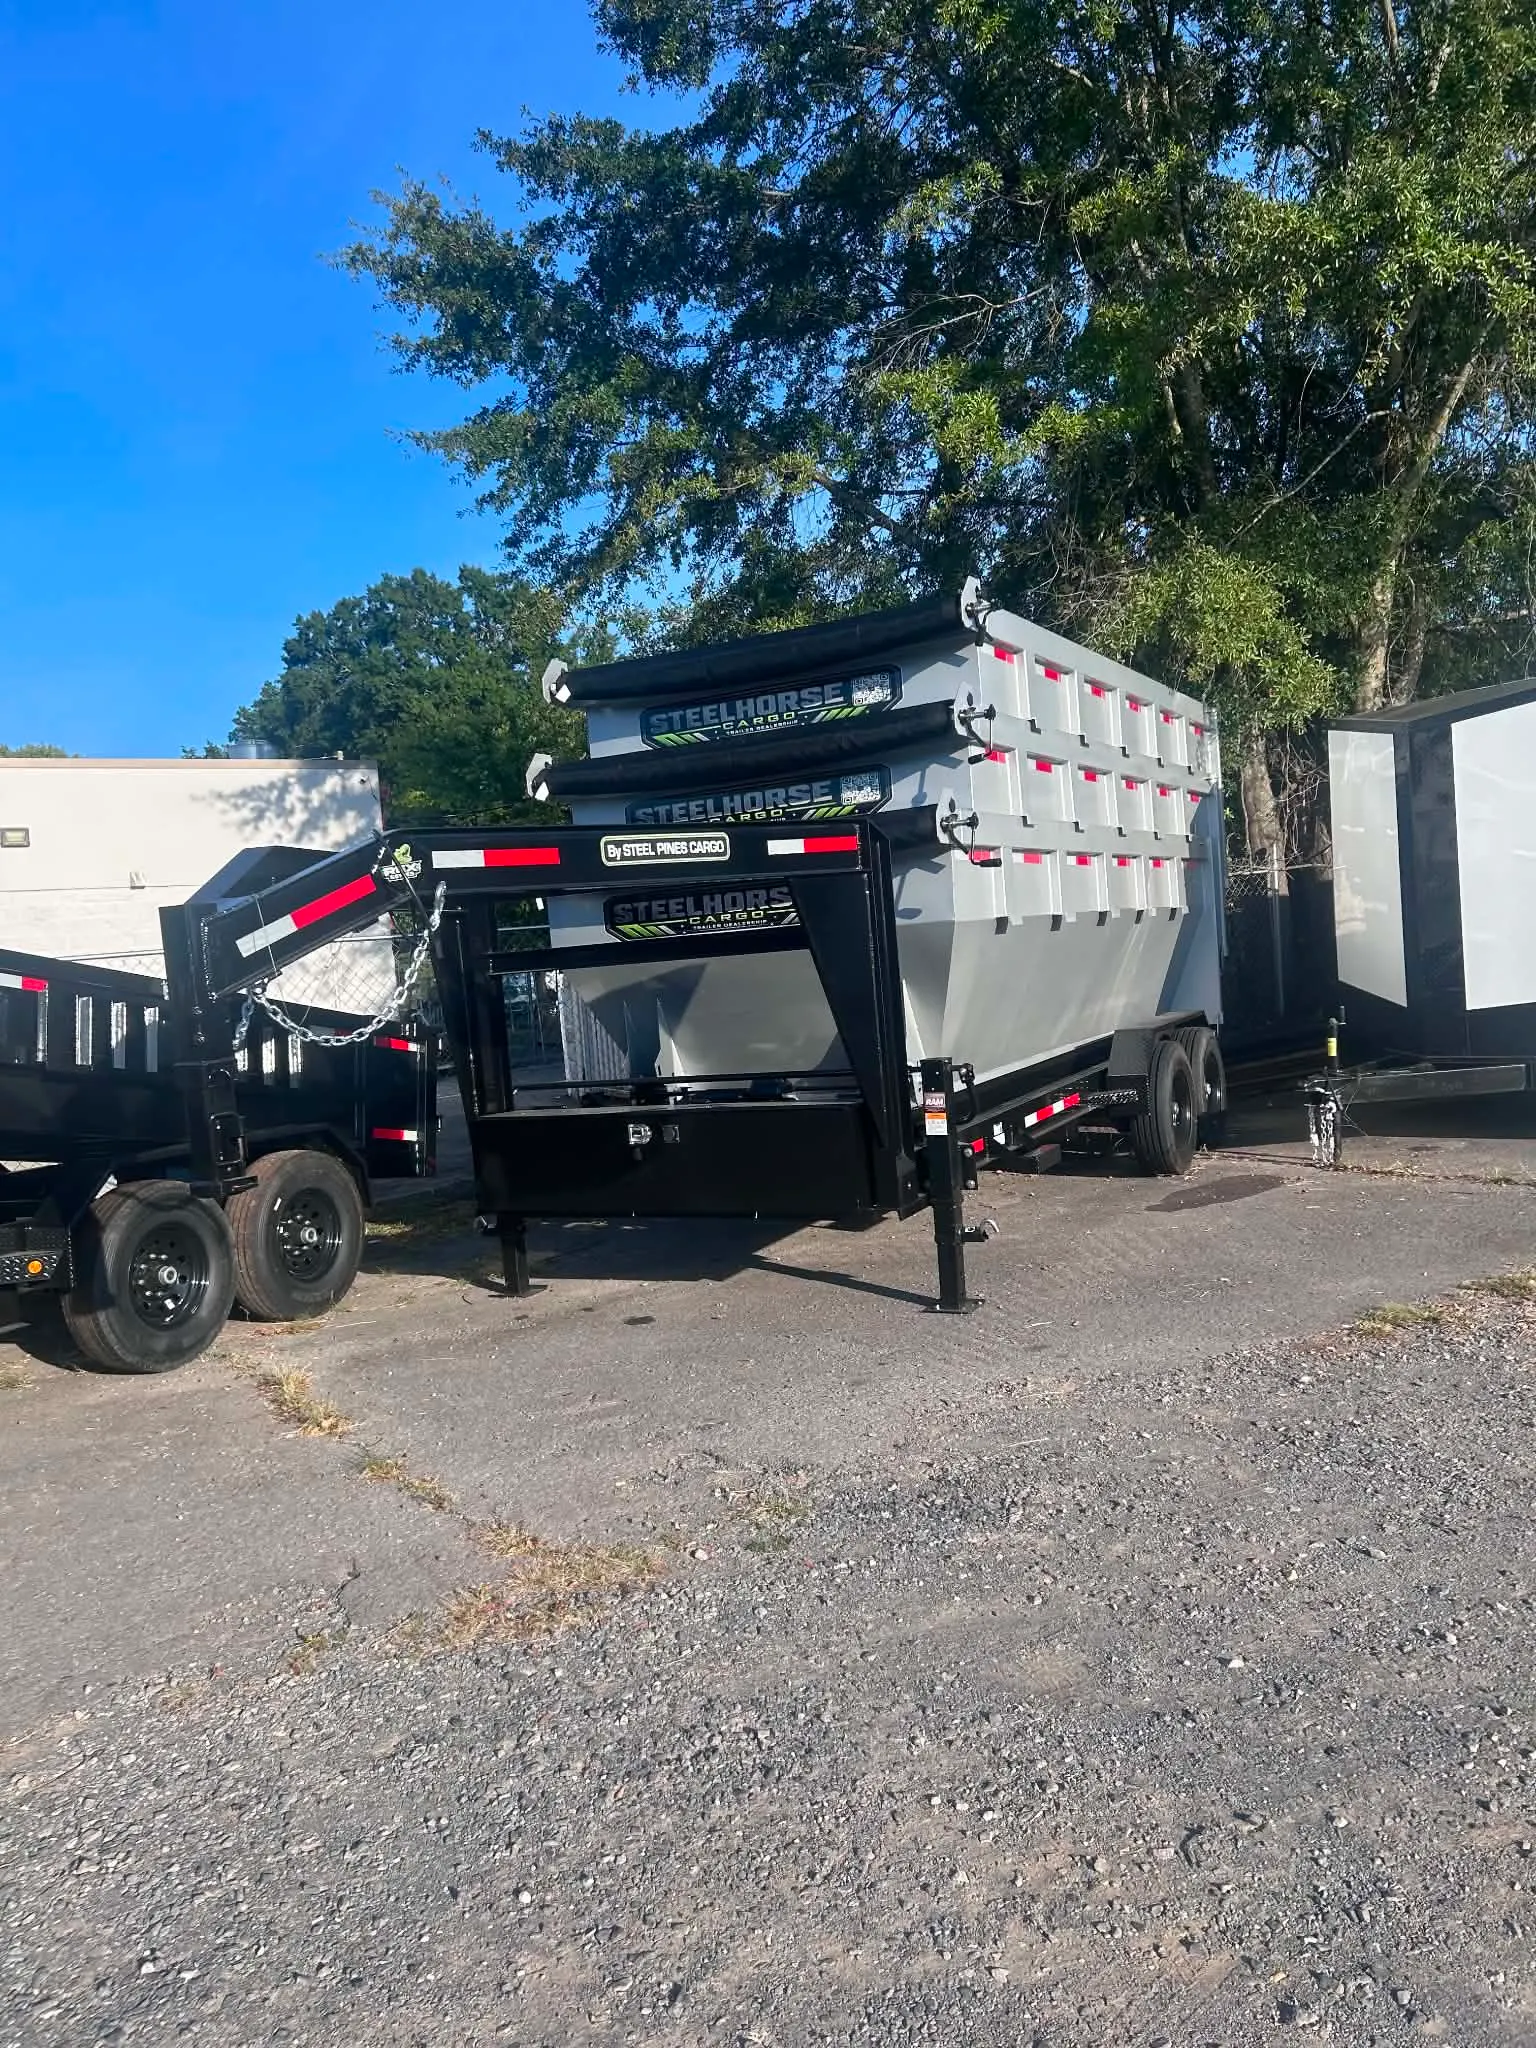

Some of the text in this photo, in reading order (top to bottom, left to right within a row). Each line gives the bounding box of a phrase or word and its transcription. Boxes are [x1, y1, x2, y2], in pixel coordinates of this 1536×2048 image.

[650, 682, 844, 734] STEELHORSE
[722, 711, 796, 731] CARGO
[726, 719, 799, 736] TRAILER DEALERSHIP
[635, 781, 833, 825] STEELHORSE
[606, 840, 725, 860] By STEEL PINES CARGO
[613, 885, 793, 924] STEELHORS
[689, 910, 764, 925] CARGO
[693, 922, 722, 931] TRAILER
[925, 1098, 944, 1106] RAM
